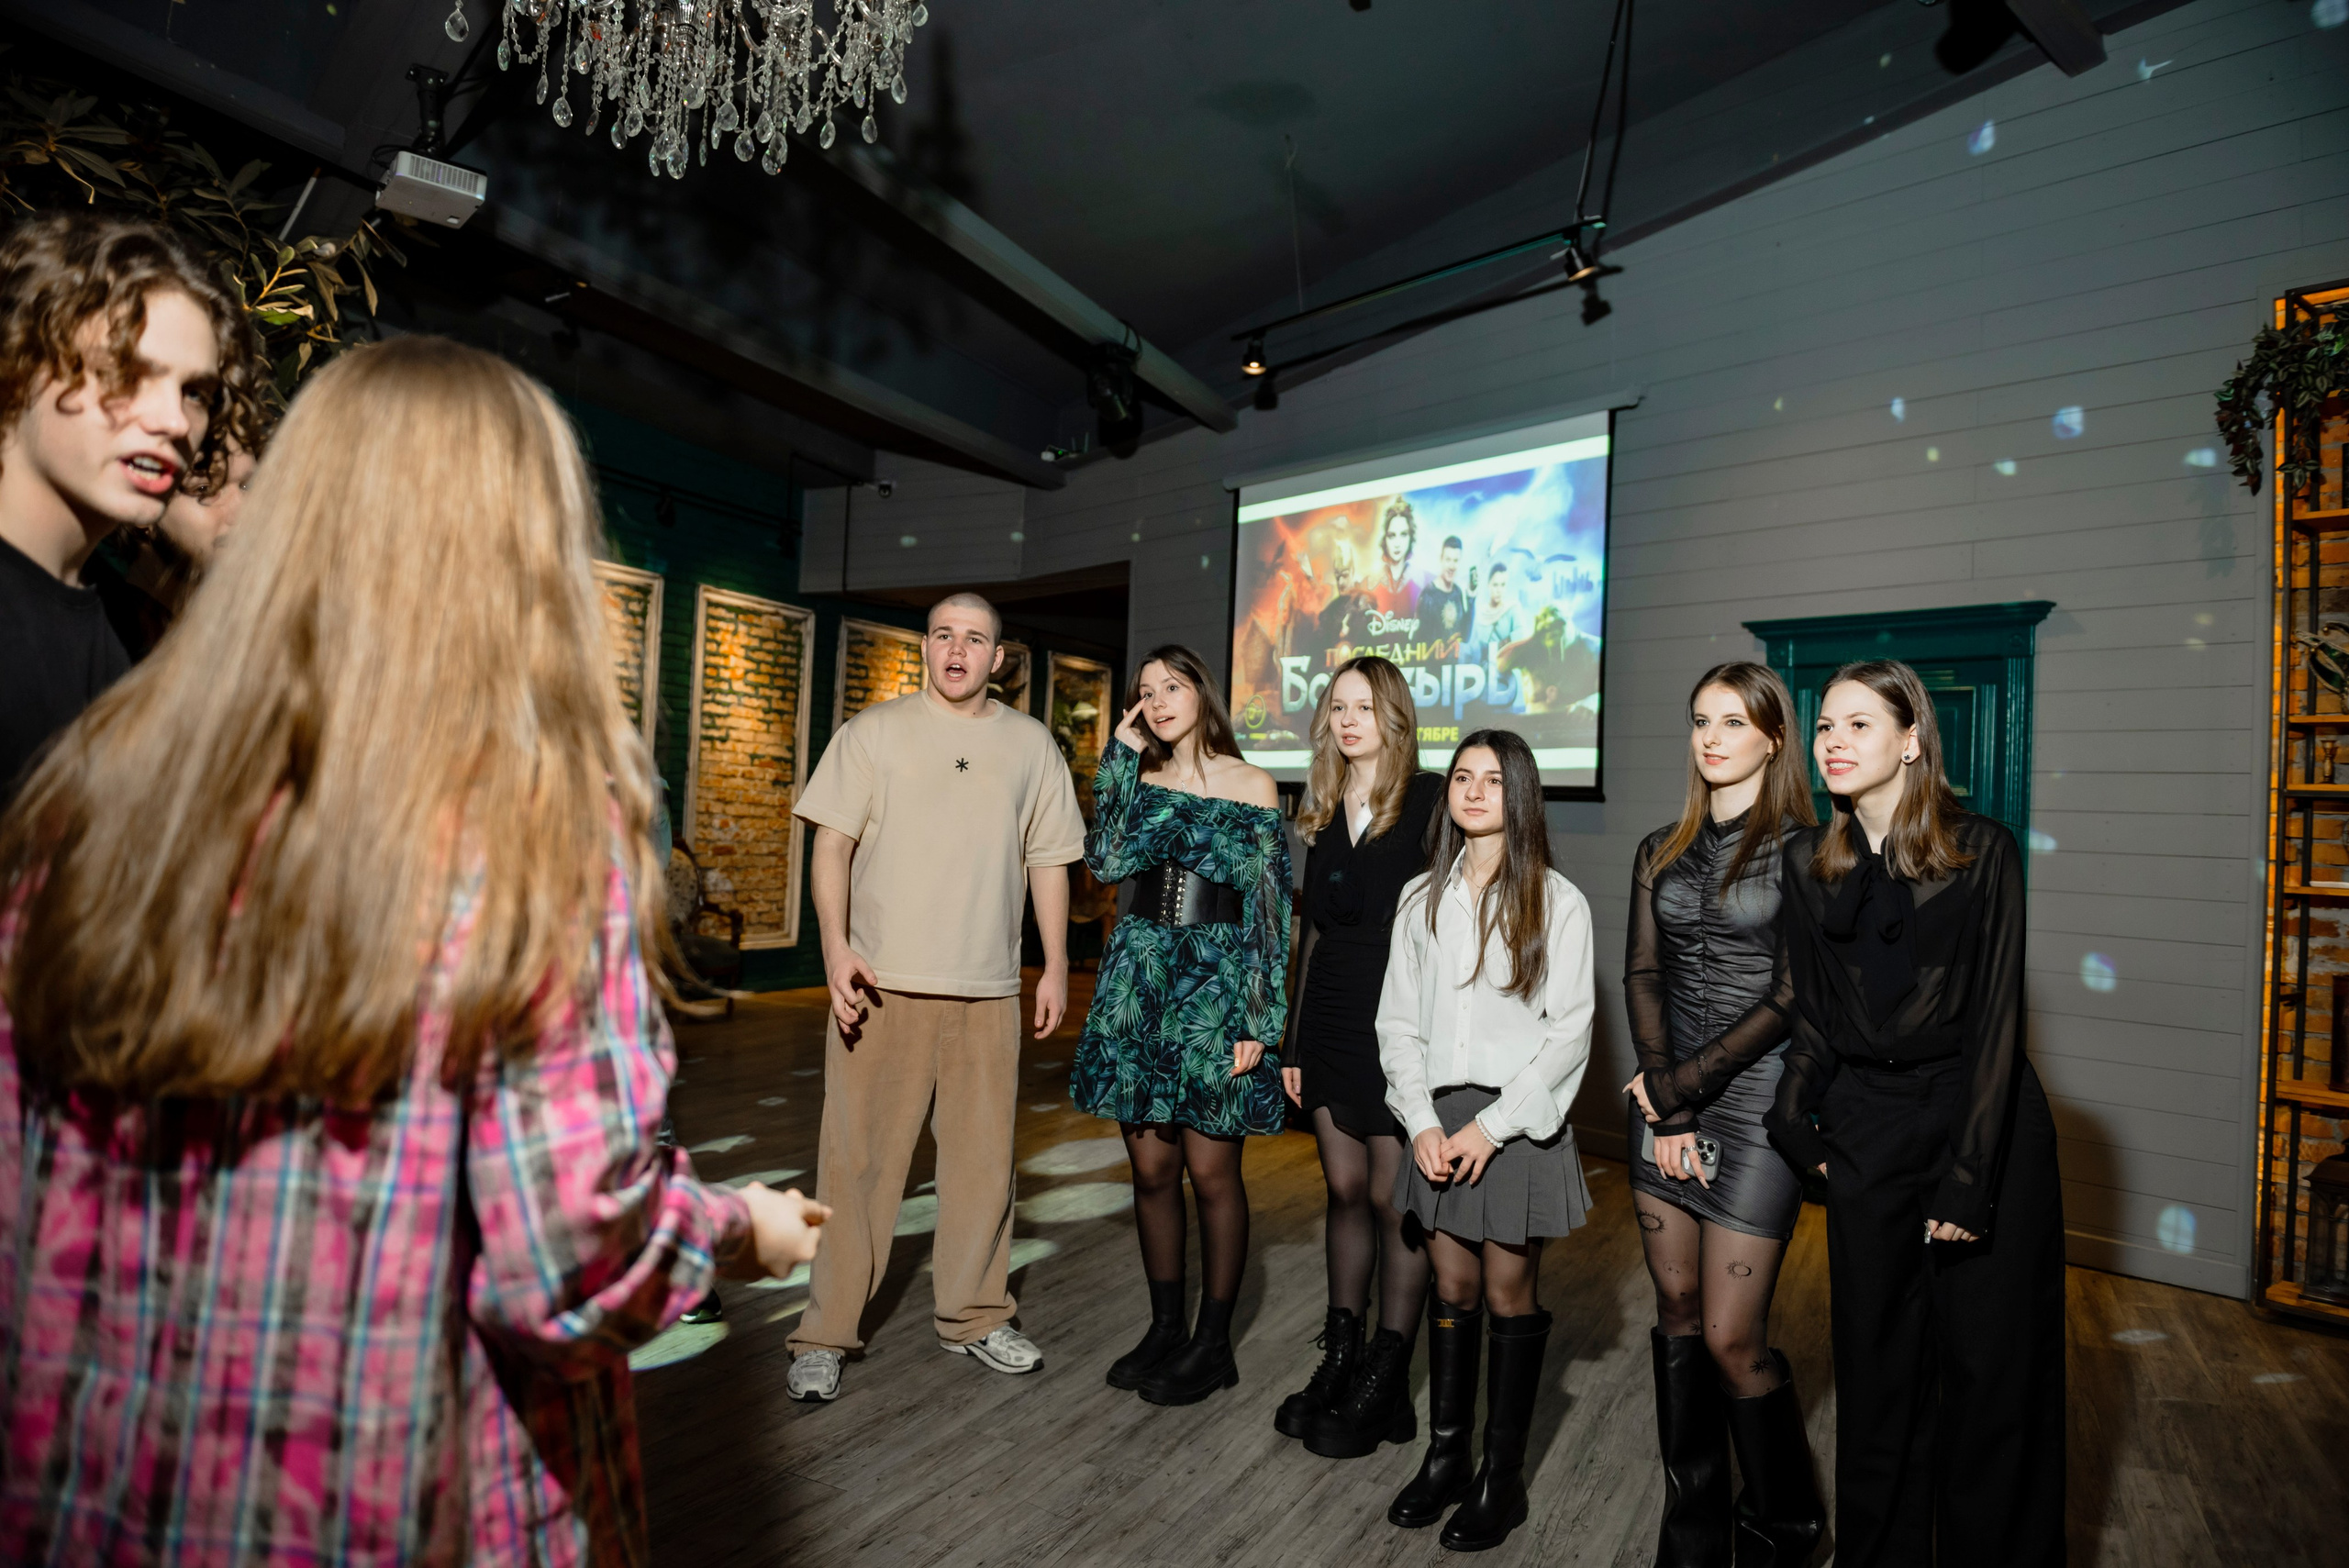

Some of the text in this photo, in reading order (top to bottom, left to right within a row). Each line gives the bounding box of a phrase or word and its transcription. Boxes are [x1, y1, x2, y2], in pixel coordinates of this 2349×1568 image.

[1365, 609, 1420, 640] Disney
[1324, 632, 1462, 667] ПОСЛЕДНИЙ
[1416, 726, 1459, 742] ТЯБРЕ
